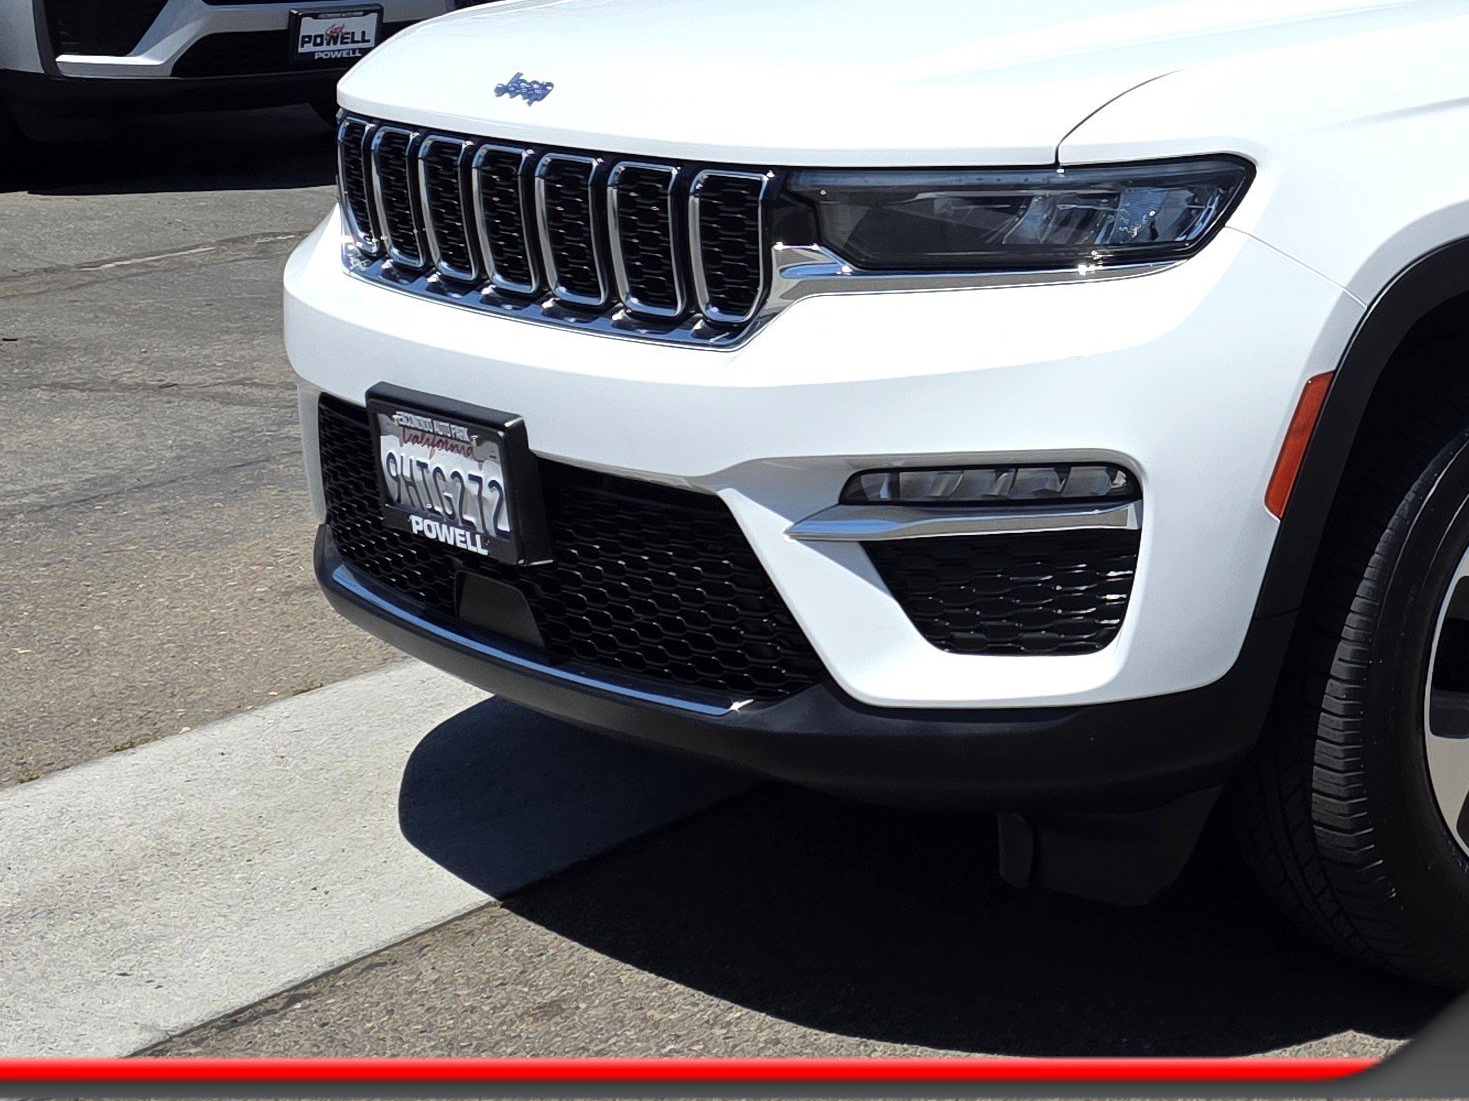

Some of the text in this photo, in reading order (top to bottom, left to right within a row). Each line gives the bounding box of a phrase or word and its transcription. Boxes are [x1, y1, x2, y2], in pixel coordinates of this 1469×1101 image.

[300, 30, 371, 48] POWELL
[314, 48, 363, 60] POWELL
[410, 514, 489, 556] POWELL
